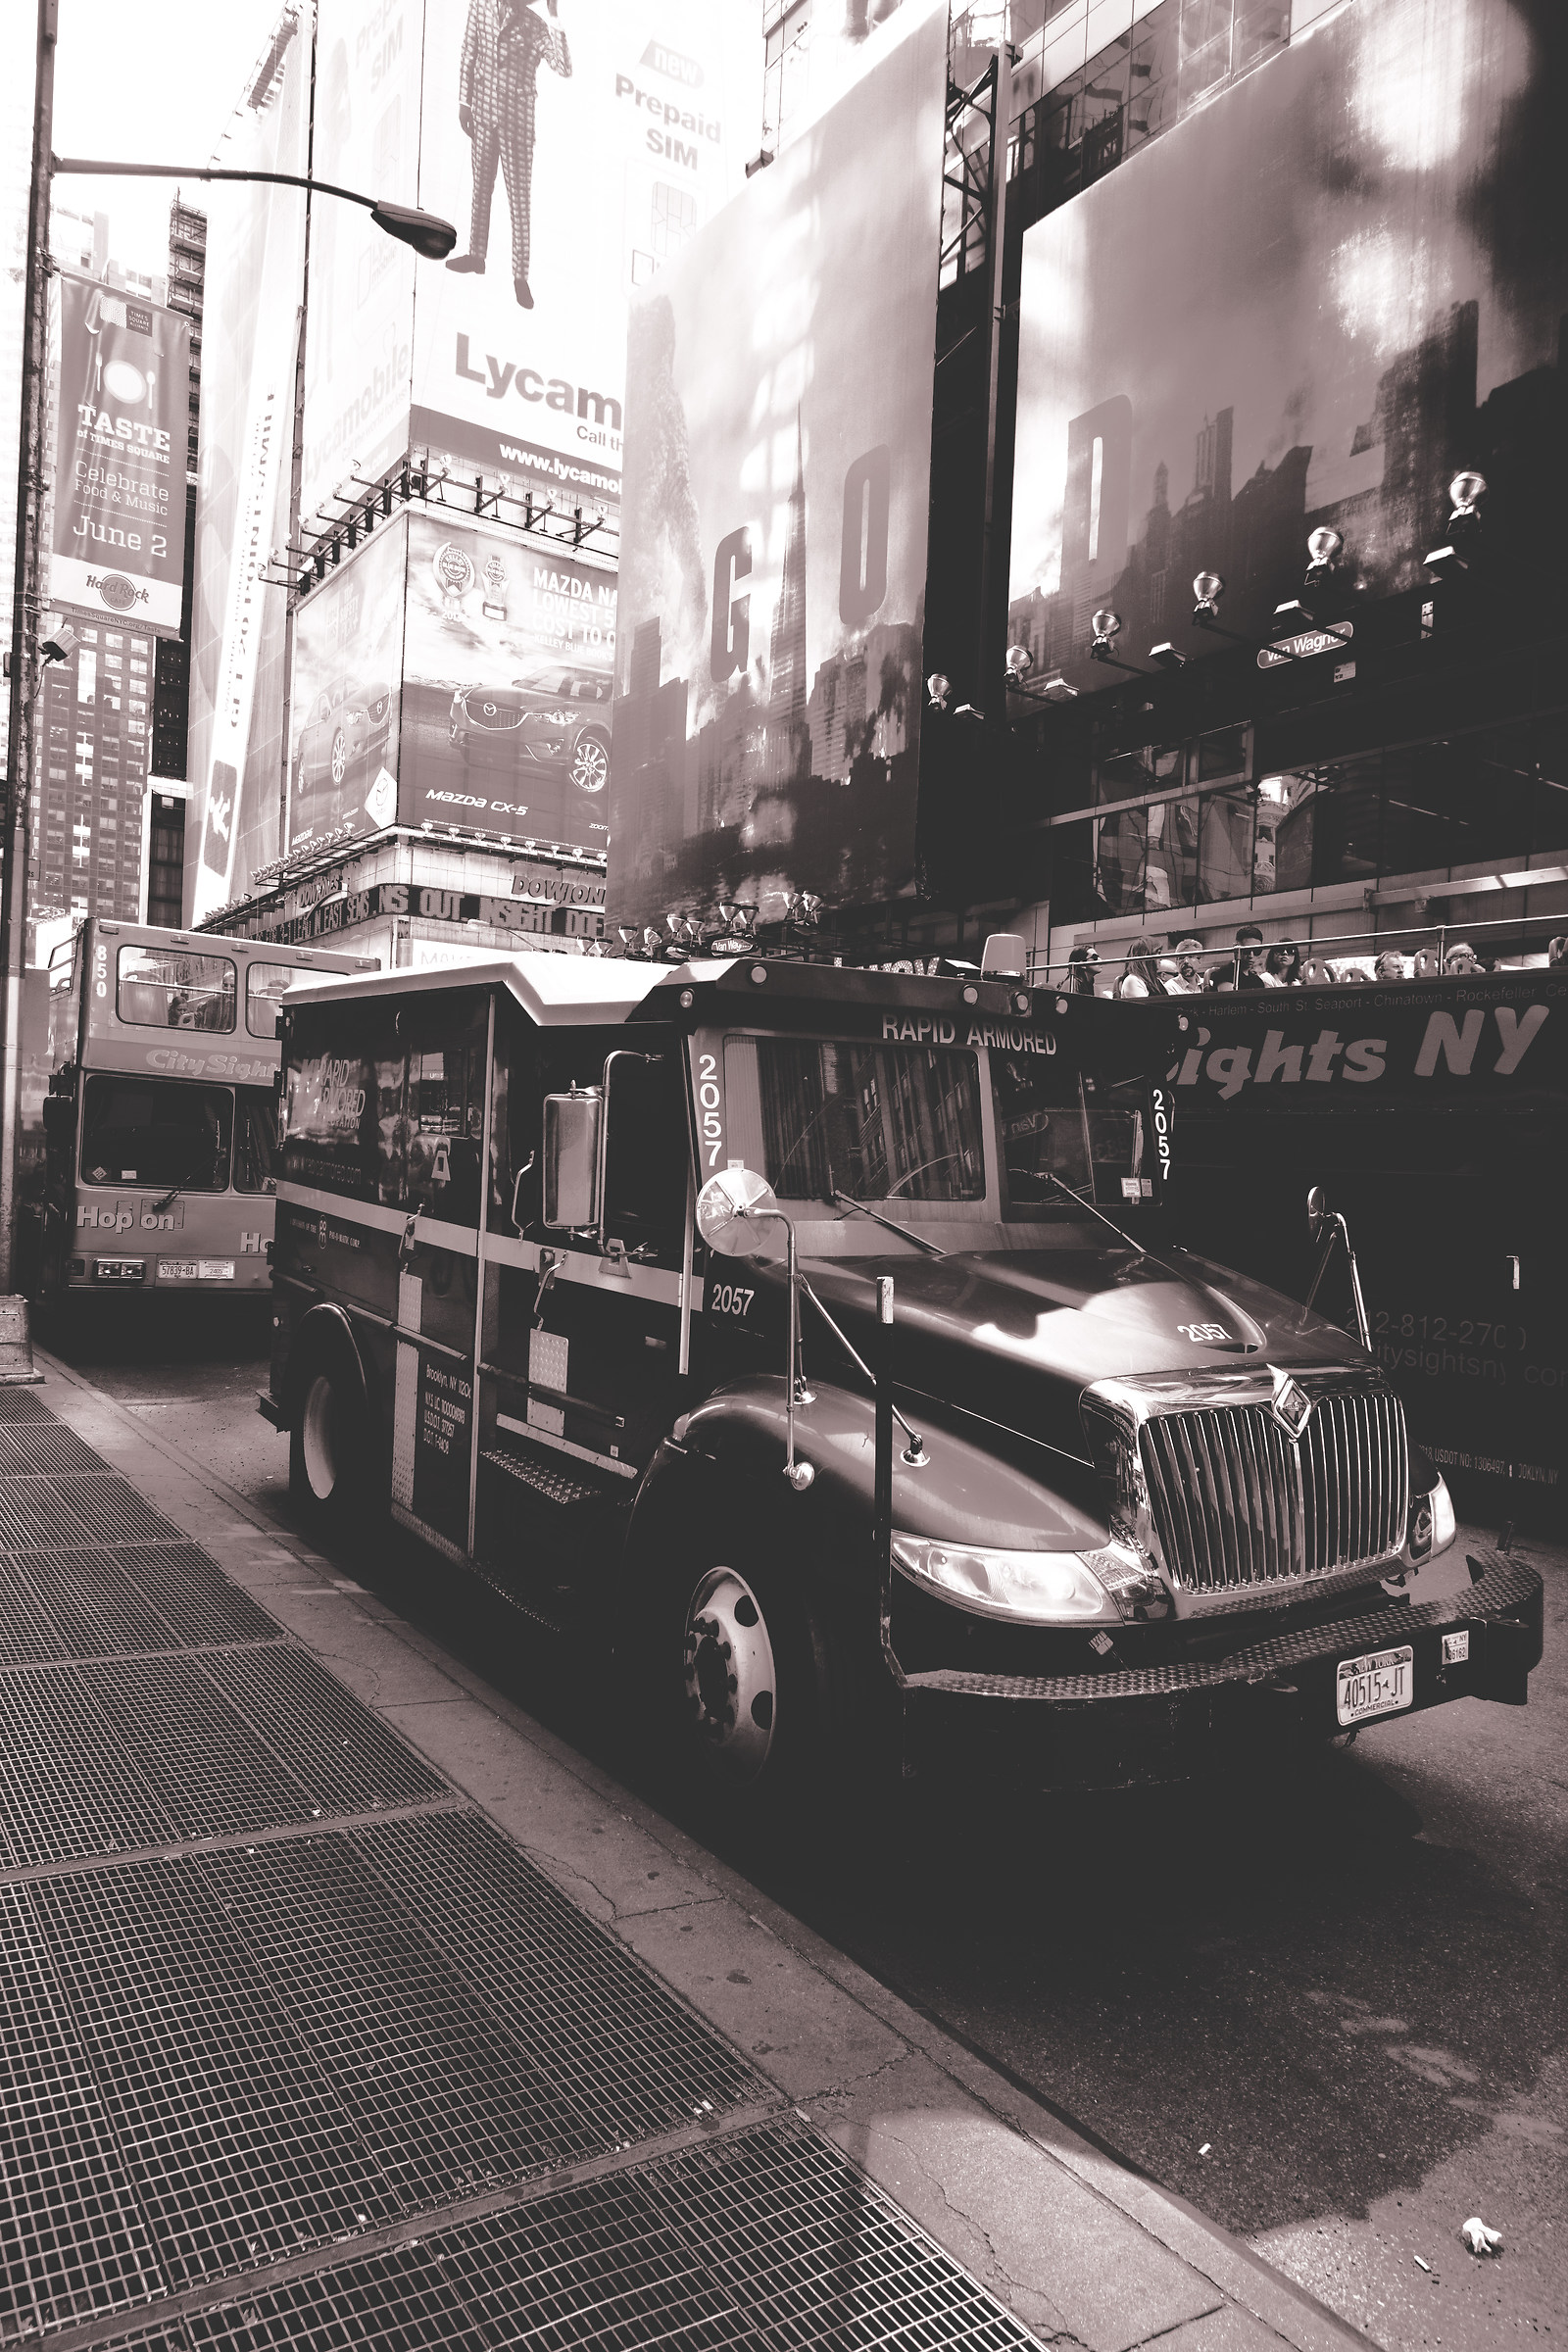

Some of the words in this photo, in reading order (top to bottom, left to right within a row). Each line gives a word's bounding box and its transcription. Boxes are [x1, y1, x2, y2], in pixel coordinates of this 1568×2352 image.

[654, 46, 698, 85] new
[614, 73, 721, 145] Prepaid
[645, 127, 699, 172] SIM
[128, 316, 150, 327] SQUARE
[130, 311, 149, 321] TIMES
[455, 331, 622, 431] Lycam
[78, 404, 171, 452] TASTE
[576, 425, 607, 447] Call
[77, 430, 88, 439] of
[90, 432, 124, 451] TIMES
[126, 444, 171, 465] SQUARE
[75, 461, 169, 501] Celebrate
[500, 443, 622, 495] www.lycamo
[74, 479, 108, 500] Food
[112, 491, 122, 504] &
[125, 494, 168, 515] Music
[73, 514, 142, 551] June
[151, 534, 167, 558] 2
[85, 574, 119, 593] Hard
[119, 583, 150, 604] Rock
[533, 566, 593, 602] MAZDA
[533, 588, 600, 624] LOWEST
[604, 609, 615, 629] 5
[532, 611, 575, 640] COST
[580, 622, 602, 646] TO
[533, 633, 564, 649] KELLEY
[565, 641, 585, 655] BLUE
[490, 801, 528, 816] CX-5
[512, 875, 564, 902] DOW
[323, 901, 343, 932] EAST
[1209, 1004, 1247, 1016] Harlem
[1256, 1001, 1290, 1013] South
[1315, 997, 1362, 1011] Seaport
[1374, 993, 1443, 1007] Chinatown
[1456, 986, 1537, 1003] Rockefeller
[882, 1014, 956, 1045] RAPID
[966, 1024, 1056, 1055] ARMORED
[1167, 1026, 1387, 1101] ights
[1414, 1004, 1550, 1076] NY
[76, 1205, 133, 1234] Hop
[141, 1212, 174, 1230] on
[711, 1283, 755, 1316] 2057
[1177, 1321, 1232, 1344] 2057
[449, 1375, 458, 1391] NY
[1435, 1447, 1458, 1465] USDOT
[1460, 1452, 1472, 1468] NO:
[1354, 1699, 1396, 1716] COMMERCIAL
